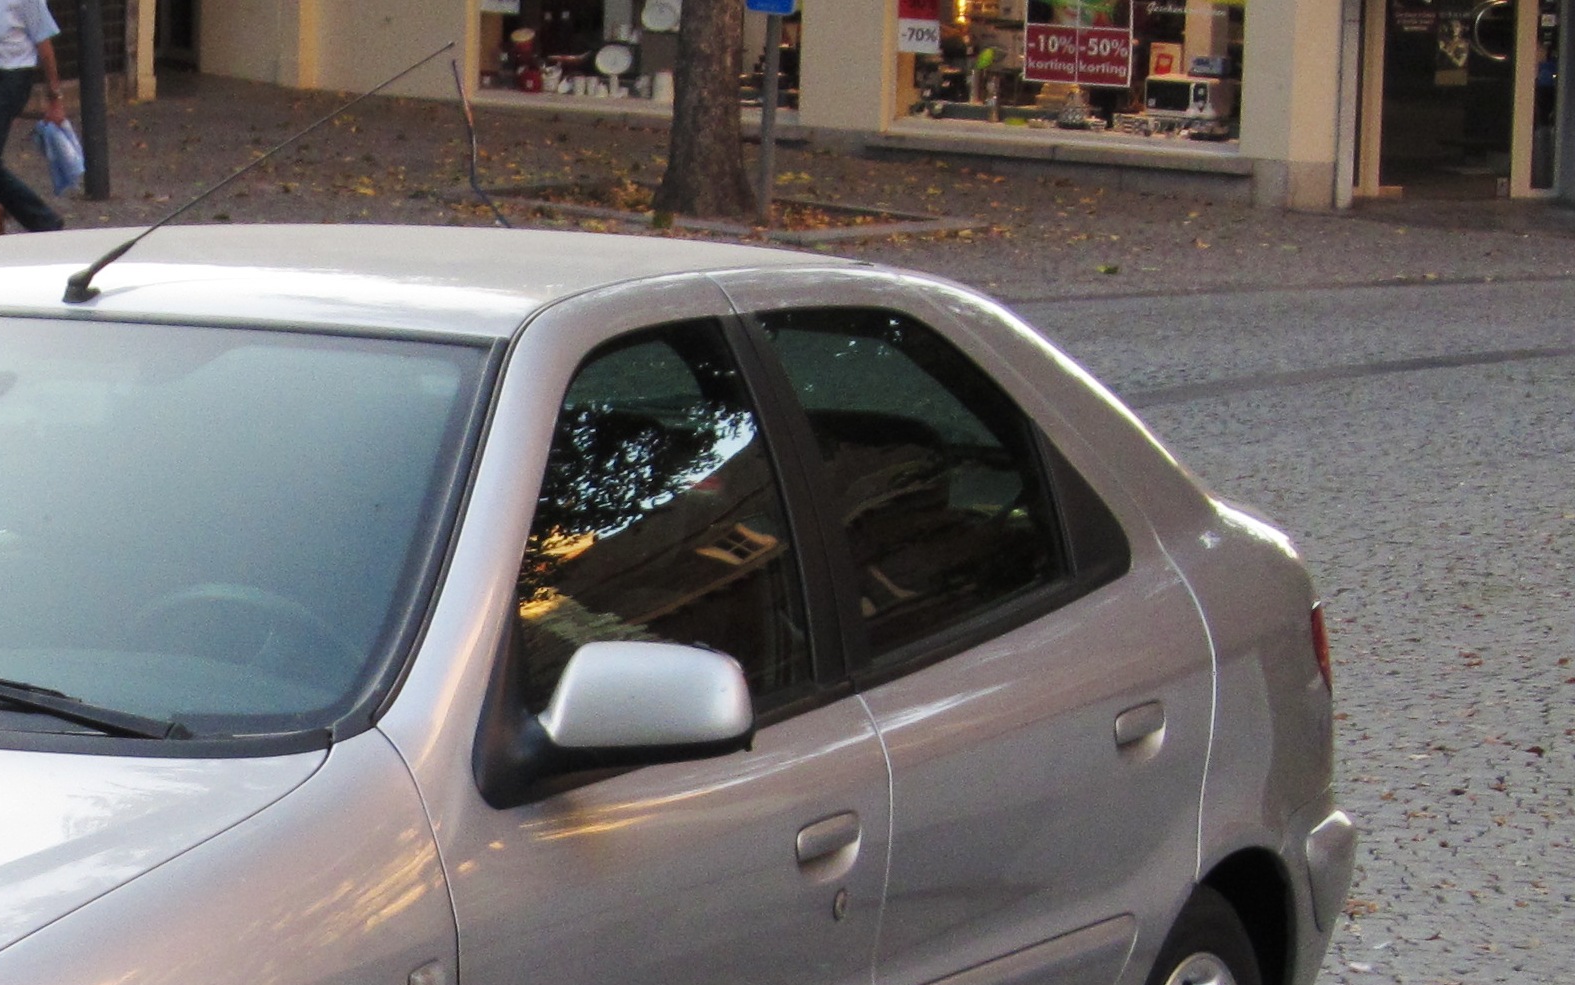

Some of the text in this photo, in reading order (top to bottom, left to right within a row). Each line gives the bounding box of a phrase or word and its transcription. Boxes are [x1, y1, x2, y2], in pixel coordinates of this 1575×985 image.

[901, 27, 937, 42] -70%
[1028, 34, 1075, 54] -10%
[1079, 38, 1129, 58] -50%
[1028, 57, 1074, 74] korting
[1079, 60, 1127, 77] korting
